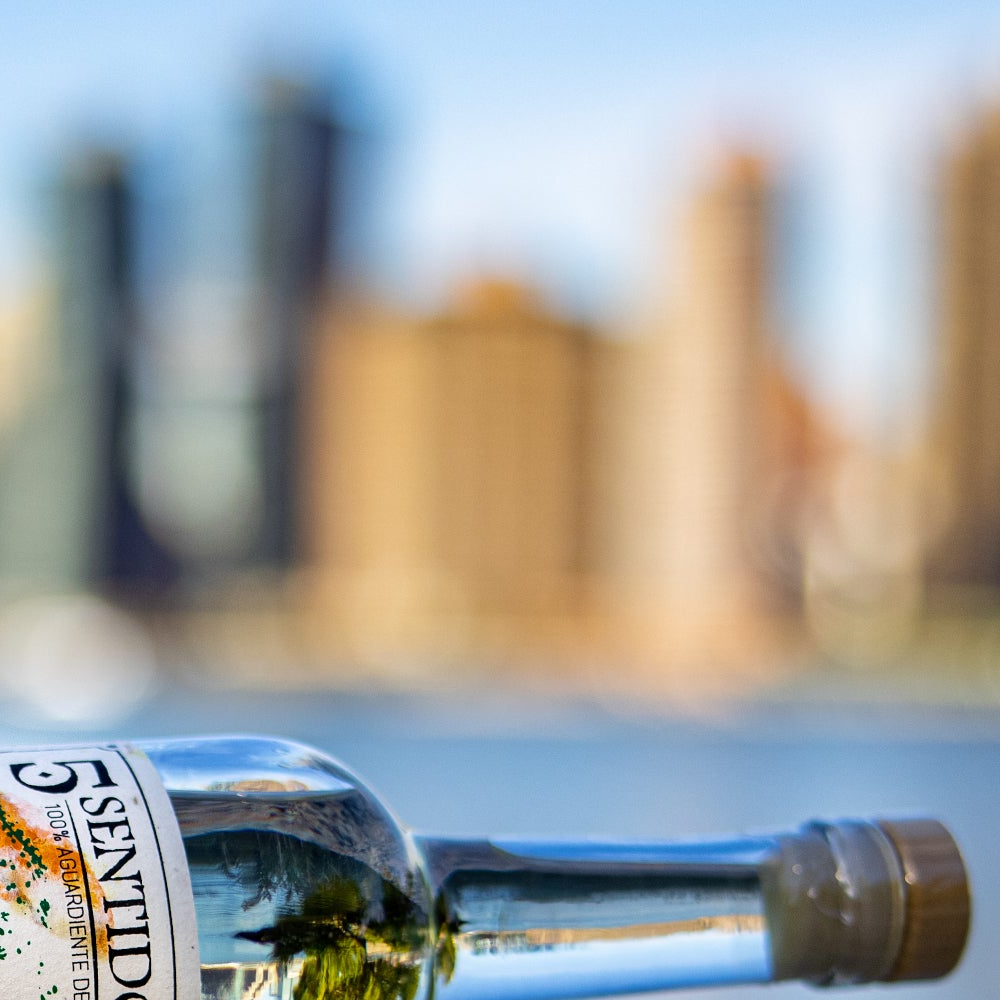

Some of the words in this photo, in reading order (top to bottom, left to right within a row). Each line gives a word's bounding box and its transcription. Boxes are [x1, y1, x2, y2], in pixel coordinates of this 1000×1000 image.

[9, 759, 118, 794] 5
[44, 803, 71, 842] 100%
[56, 847, 90, 972] AGUARDIENTE
